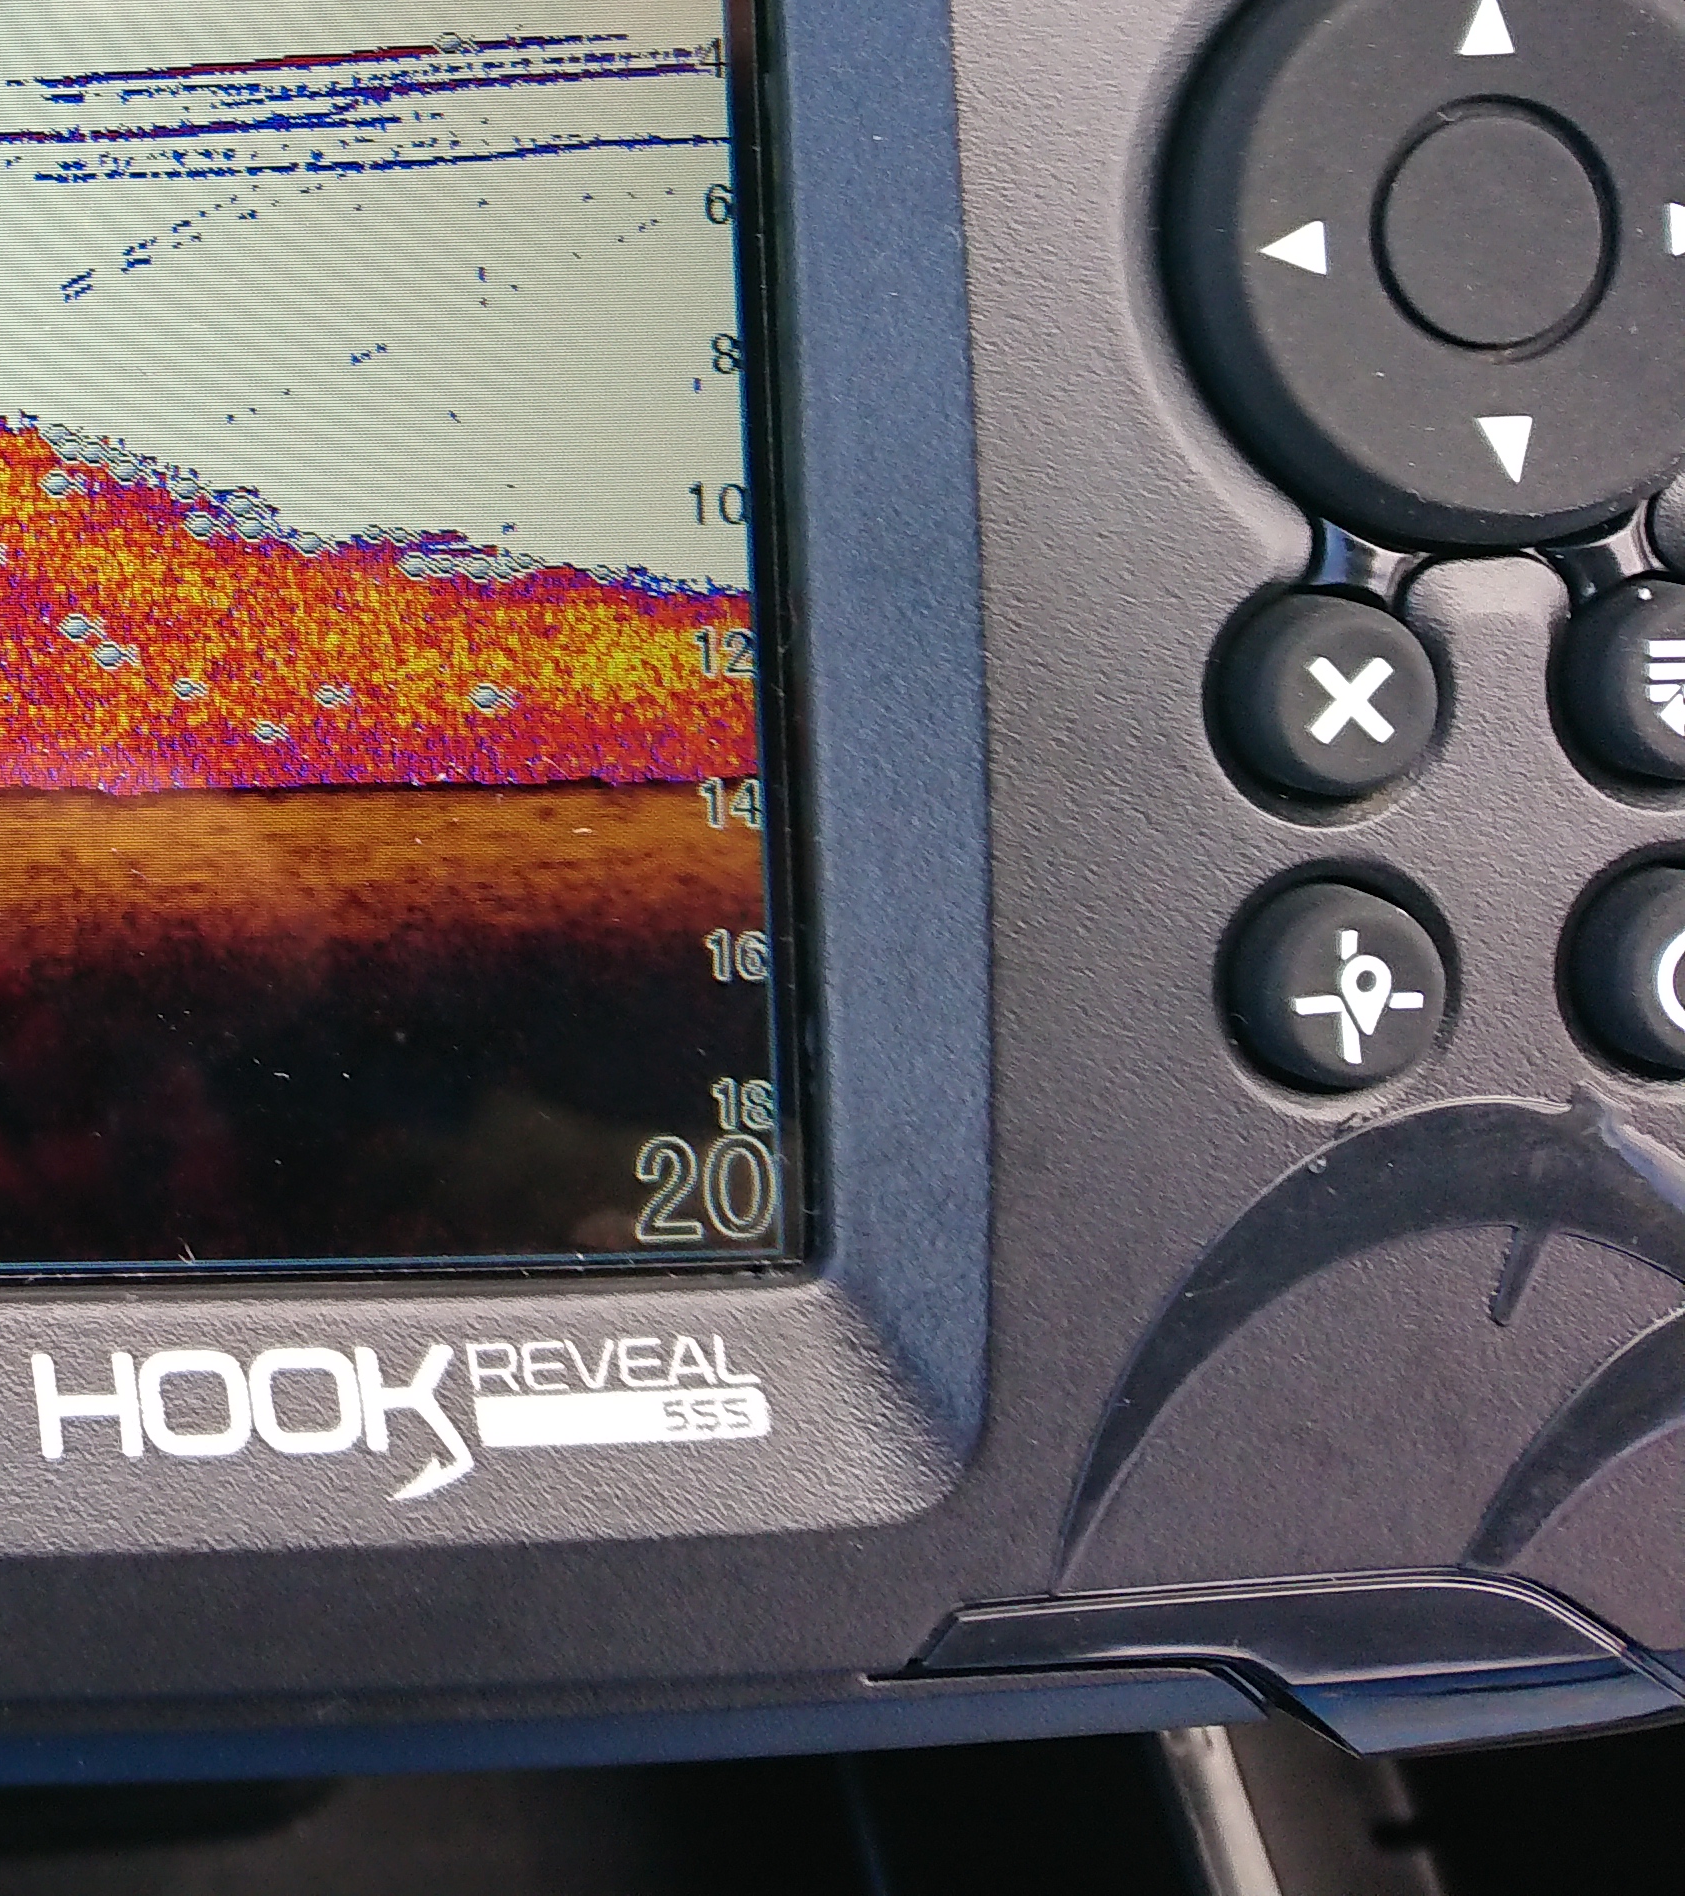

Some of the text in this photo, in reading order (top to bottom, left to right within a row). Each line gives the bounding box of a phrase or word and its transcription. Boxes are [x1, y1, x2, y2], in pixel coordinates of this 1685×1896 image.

[694, 626, 756, 678] 12
[698, 776, 763, 830] 14
[703, 927, 770, 983] 16
[634, 1134, 777, 1244] 20
[29, 1334, 761, 1502] HOOK REVEAL
